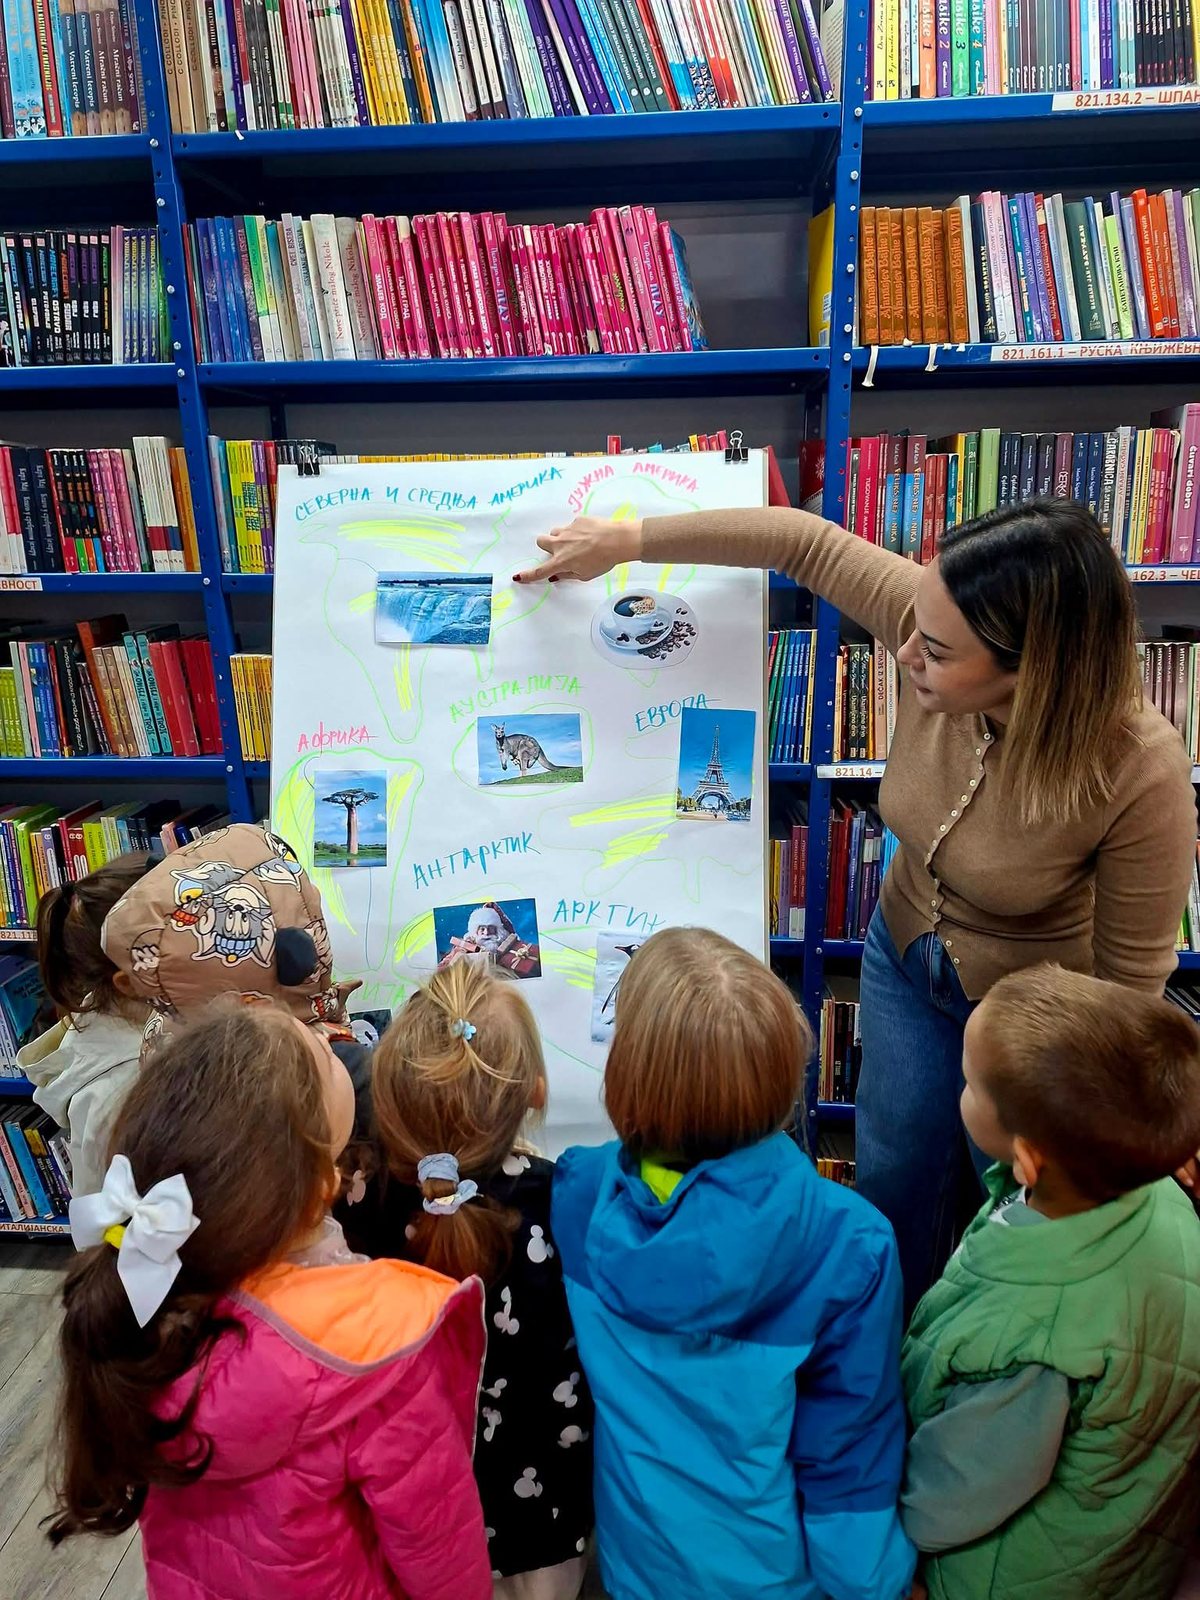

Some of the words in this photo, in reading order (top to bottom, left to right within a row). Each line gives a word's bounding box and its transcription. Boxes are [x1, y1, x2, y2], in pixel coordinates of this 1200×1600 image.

[163, 29, 171, 65] COLLODI
[173, 28, 182, 65] COLLODI
[939, 39, 950, 49] 2
[956, 41, 966, 49] 3
[972, 39, 983, 48] 4
[69, 51, 78, 80] Vatreni
[84, 50, 93, 79] Vatreni
[1075, 92, 1143, 108] 821.134.2
[864, 224, 871, 234] II
[892, 222, 898, 237] IV
[906, 225, 914, 236] V
[921, 219, 929, 235] VI
[950, 212, 960, 236] VIII
[322, 241, 334, 270] Nikole
[345, 243, 357, 271] Nikole
[863, 236, 875, 267] Bajke
[878, 237, 889, 268] Bajke
[892, 239, 903, 269] Bajke
[906, 238, 918, 267] Bajke
[922, 236, 934, 267] Bajke
[952, 236, 965, 267] Bajke
[50, 249, 59, 298] MINECRAFT
[61, 253, 69, 299] MINECRAFT
[326, 270, 338, 296] malog
[349, 272, 361, 298] malog
[397, 275, 407, 298] ТАЈНИ
[865, 268, 877, 319] Afanasjev
[879, 268, 892, 319] Afanasjev
[893, 269, 904, 320] Afanasjev
[907, 269, 920, 319] Afanasjev
[923, 267, 937, 318] Afanasjev
[953, 268, 966, 319] Afanasjev
[52, 300, 61, 333] OSTRVO
[378, 302, 388, 320] КОД
[401, 300, 411, 320] ГРАД
[334, 318, 344, 340] Nove
[357, 320, 368, 341] Nove
[1002, 346, 1064, 360] 821.161.1
[1080, 344, 1123, 357] РУСКА
[1103, 438, 1119, 486] ČAROBNICA
[294, 486, 377, 521] СЕВЕРНА
[386, 486, 398, 504] И
[407, 487, 478, 512] СРЕДЊА
[487, 465, 567, 507] АМЕРИКА
[567, 464, 616, 514] ЈУЖНА
[632, 461, 700, 493] АМЕРИКА
[863, 476, 871, 514] TUGOVANJE
[1183, 480, 1195, 509] dobra
[890, 522, 899, 543] NIKA
[910, 522, 919, 543] NIKA
[0, 580, 37, 590] ВНОСТ
[1181, 569, 1200, 580] ЧЕ
[1178, 647, 1186, 683] МУСАШИ
[449, 674, 583, 723] АУСТРАЛИЈА
[876, 677, 885, 700] DEČAK
[634, 693, 721, 733] ЕВРОПА
[835, 767, 872, 777] 821.14
[412, 831, 541, 890] АНТАРКТИК
[0, 1223, 64, 1233] ИТАЛИЈАНСКА
